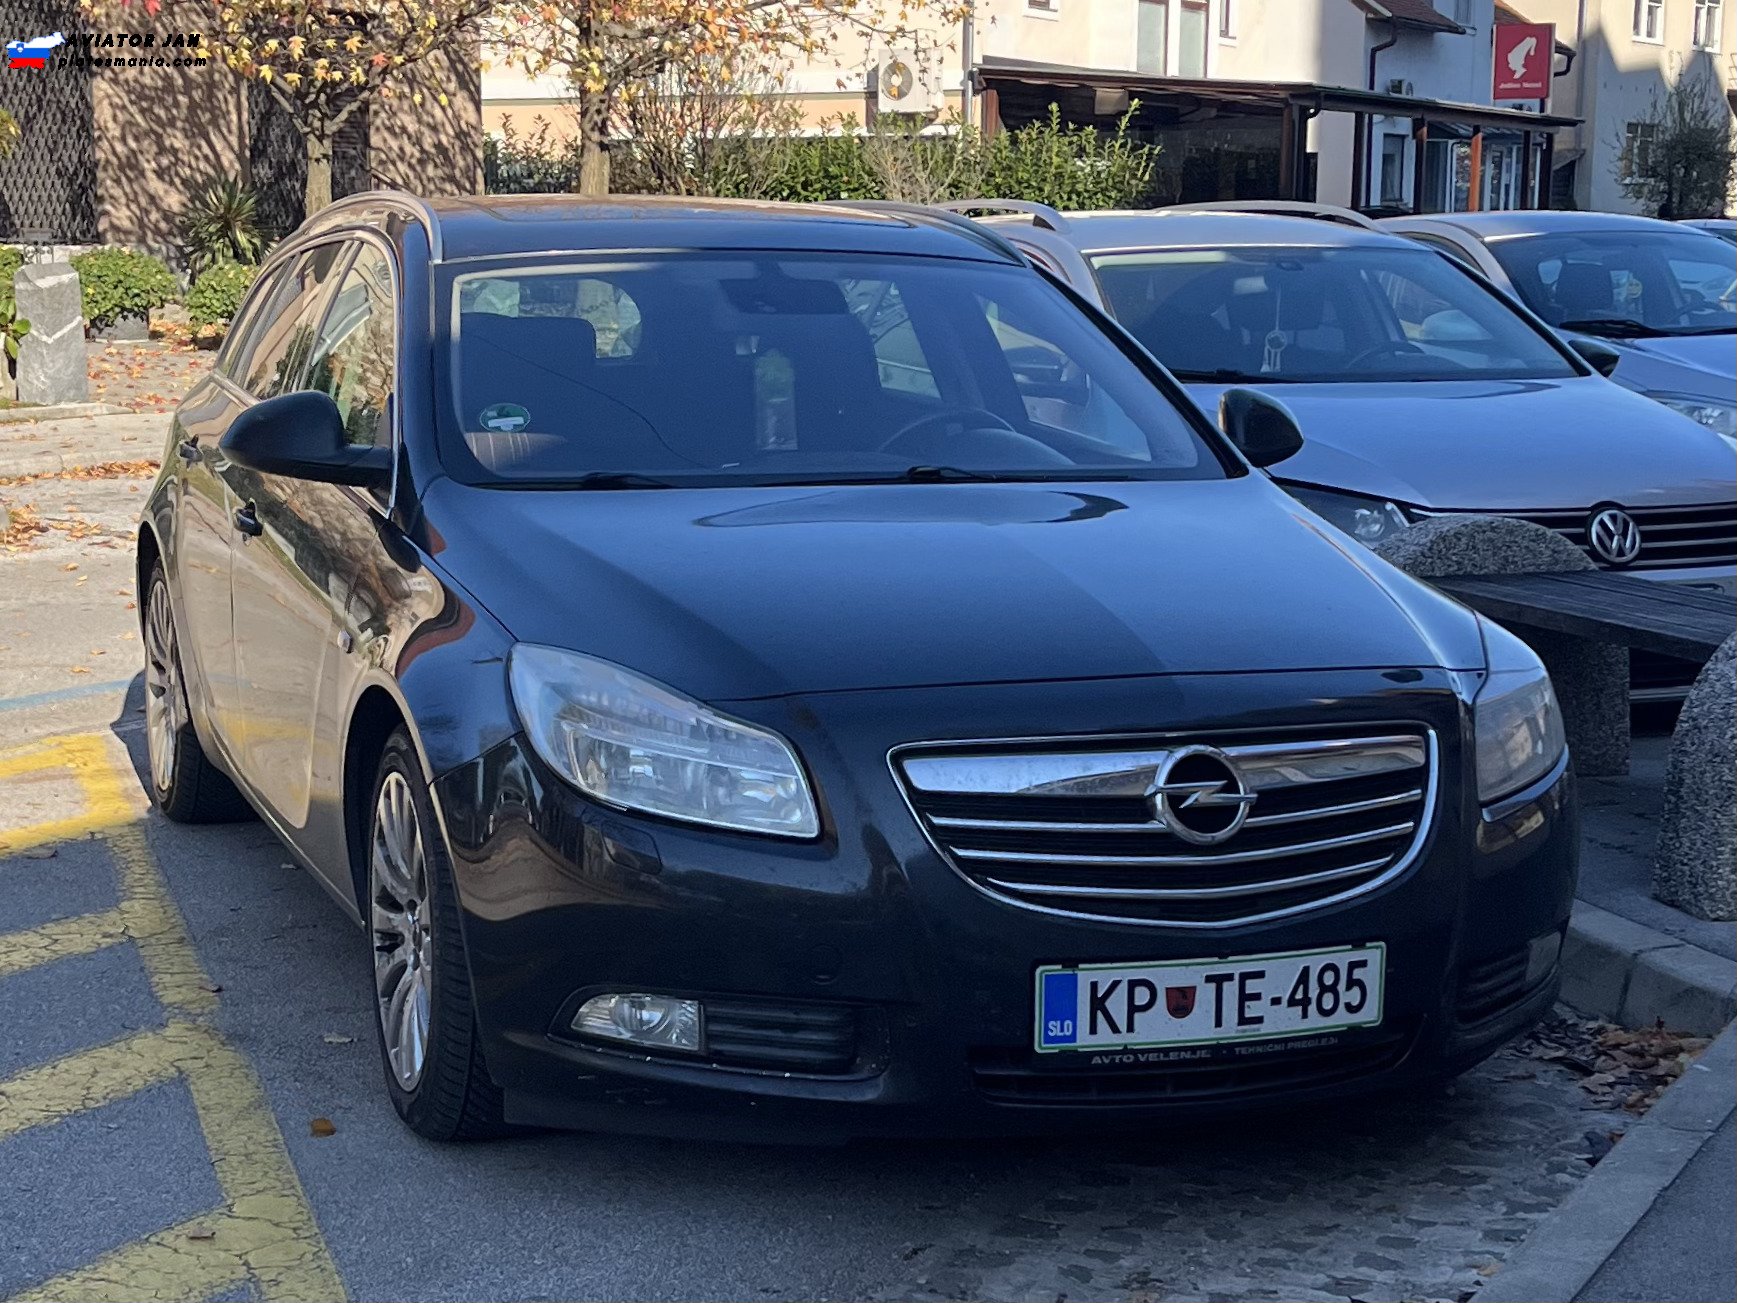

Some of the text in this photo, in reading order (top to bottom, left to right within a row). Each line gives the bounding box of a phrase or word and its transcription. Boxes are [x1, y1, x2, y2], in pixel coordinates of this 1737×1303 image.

[1088, 959, 1368, 1036] KP TE-485
[1047, 1019, 1074, 1037] SLO
[1091, 1053, 1135, 1065] AVTO
[1136, 1049, 1212, 1062] VELENJE
